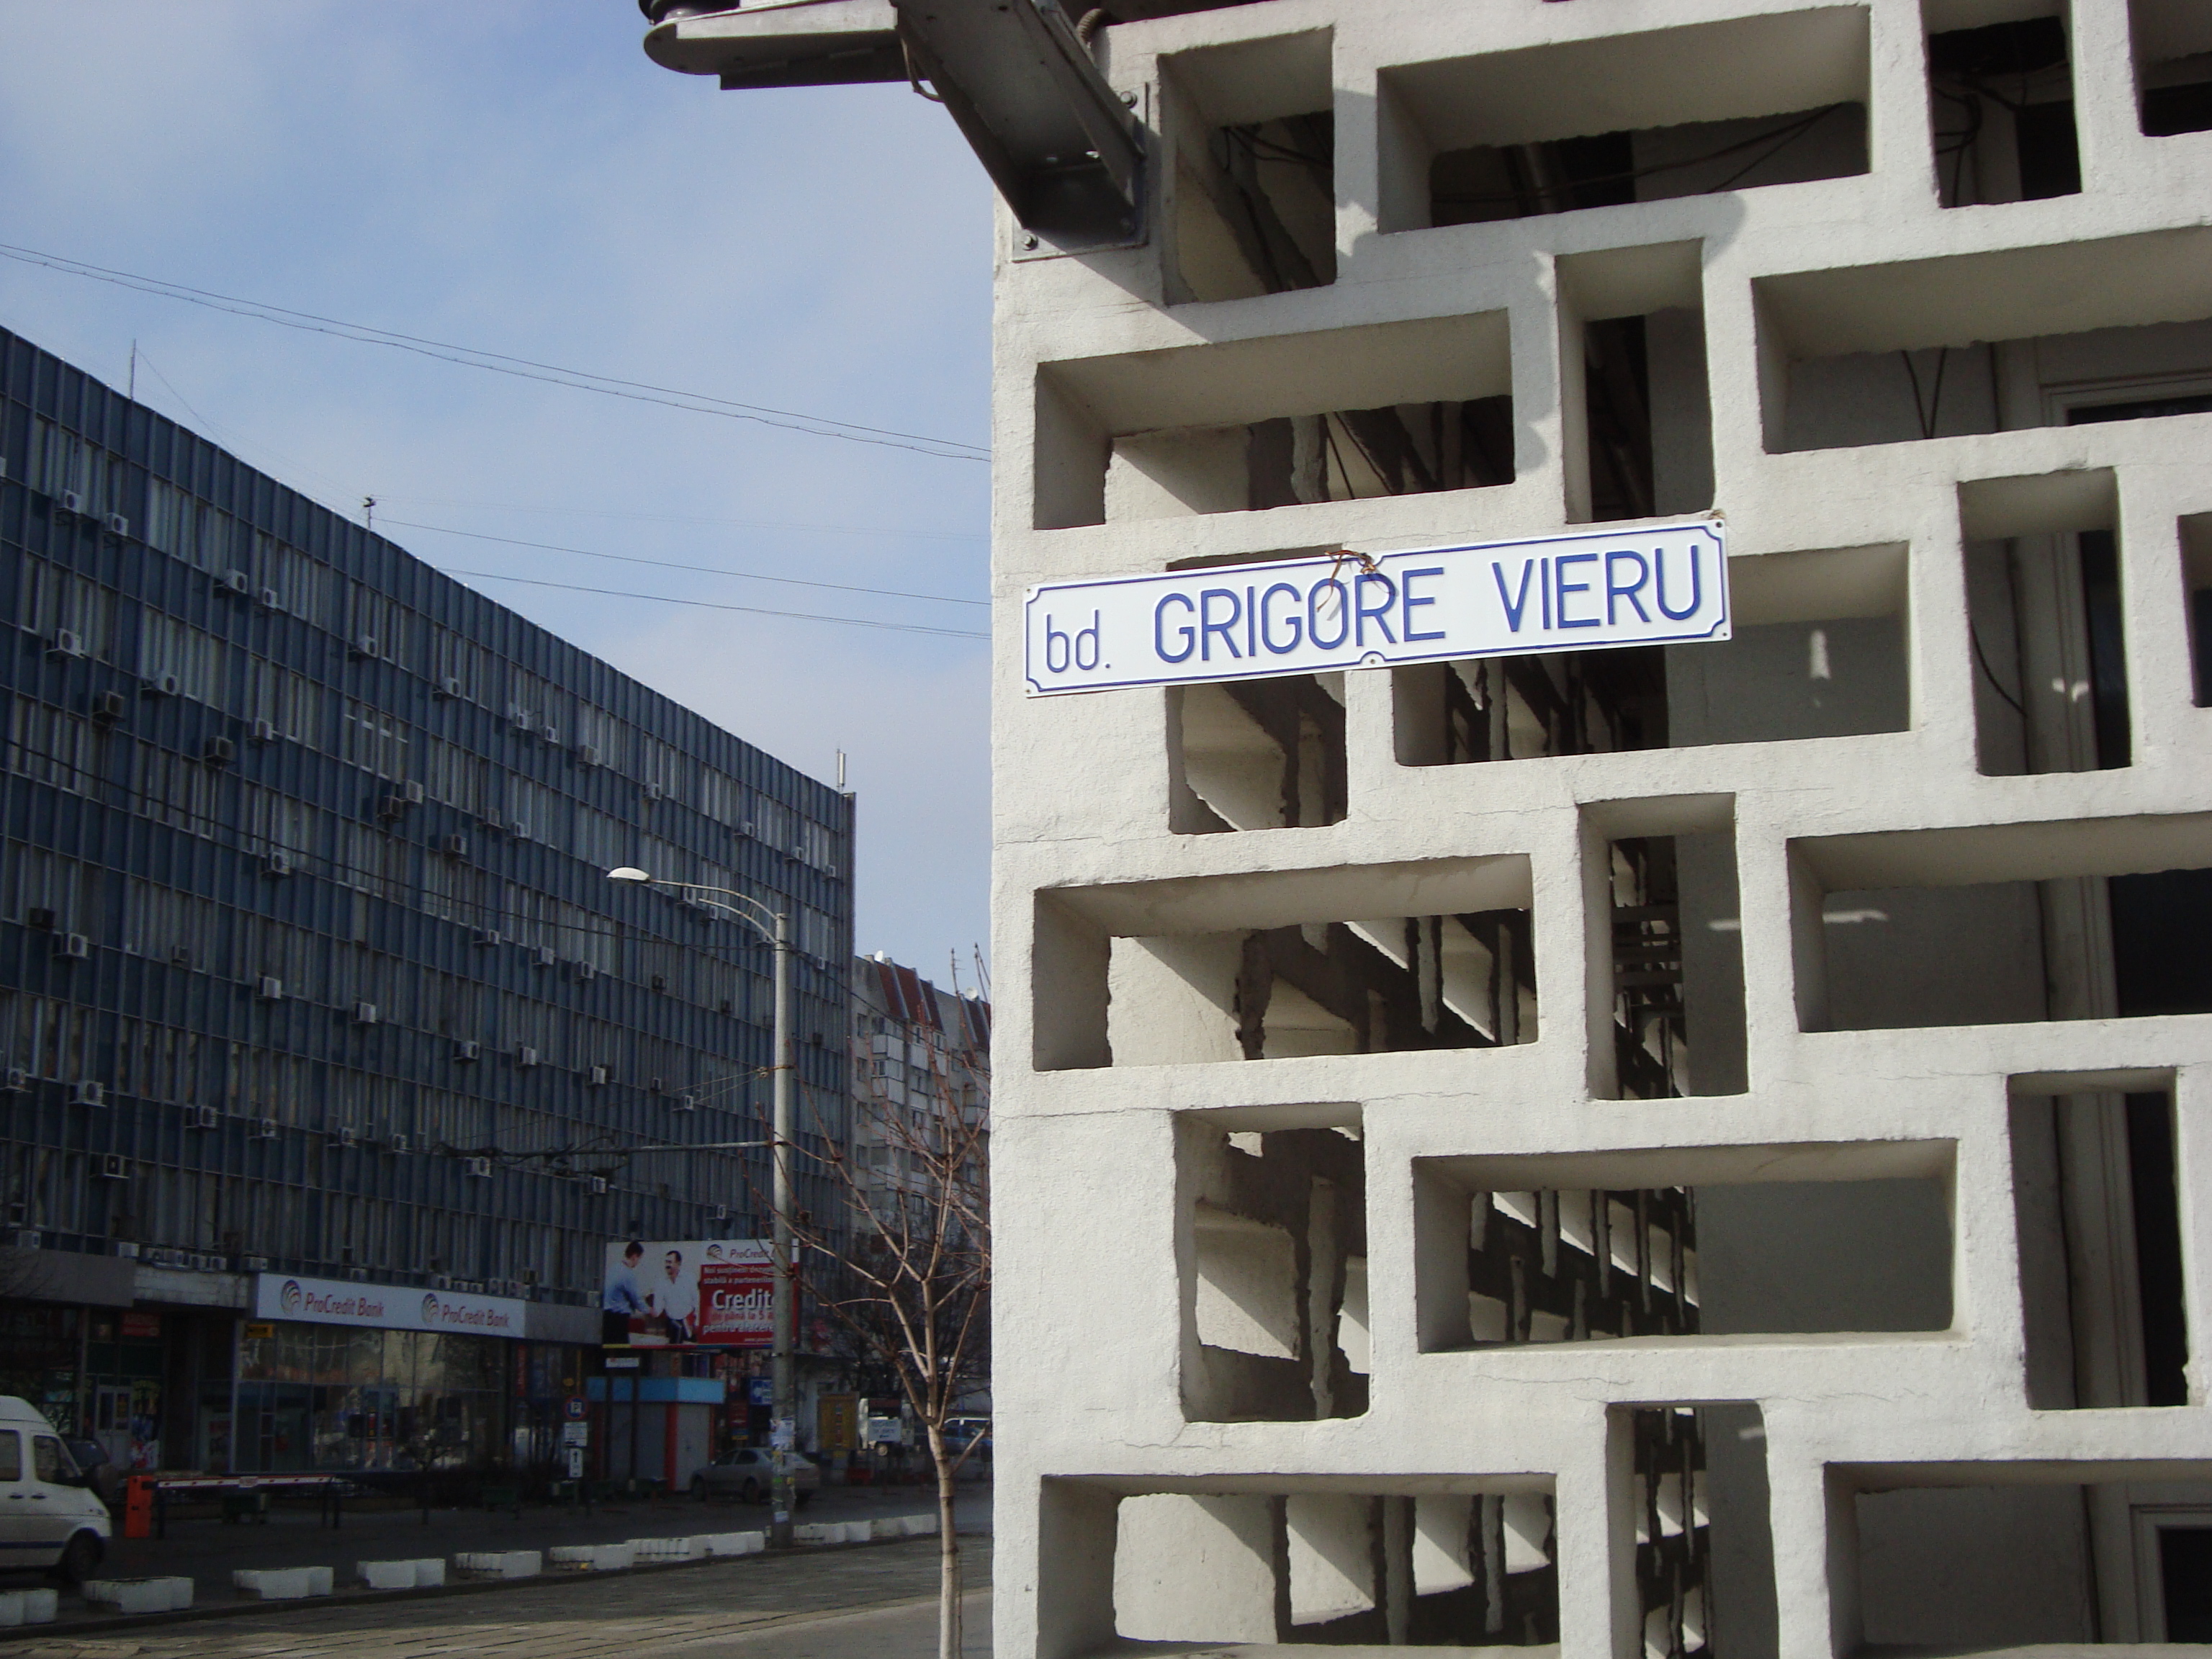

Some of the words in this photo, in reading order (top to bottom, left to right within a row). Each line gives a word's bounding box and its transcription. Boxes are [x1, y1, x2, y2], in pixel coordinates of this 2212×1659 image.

[1046, 609, 1111, 673] bd.
[1154, 566, 1446, 664] GRIGORE
[1492, 545, 1701, 634] VIERU
[303, 1292, 356, 1316] ProCredit
[357, 1298, 384, 1317] Bank
[711, 1288, 774, 1310] Credit
[441, 1304, 485, 1325] ProCredit
[487, 1309, 510, 1328] Bank
[758, 1309, 765, 1321] 5
